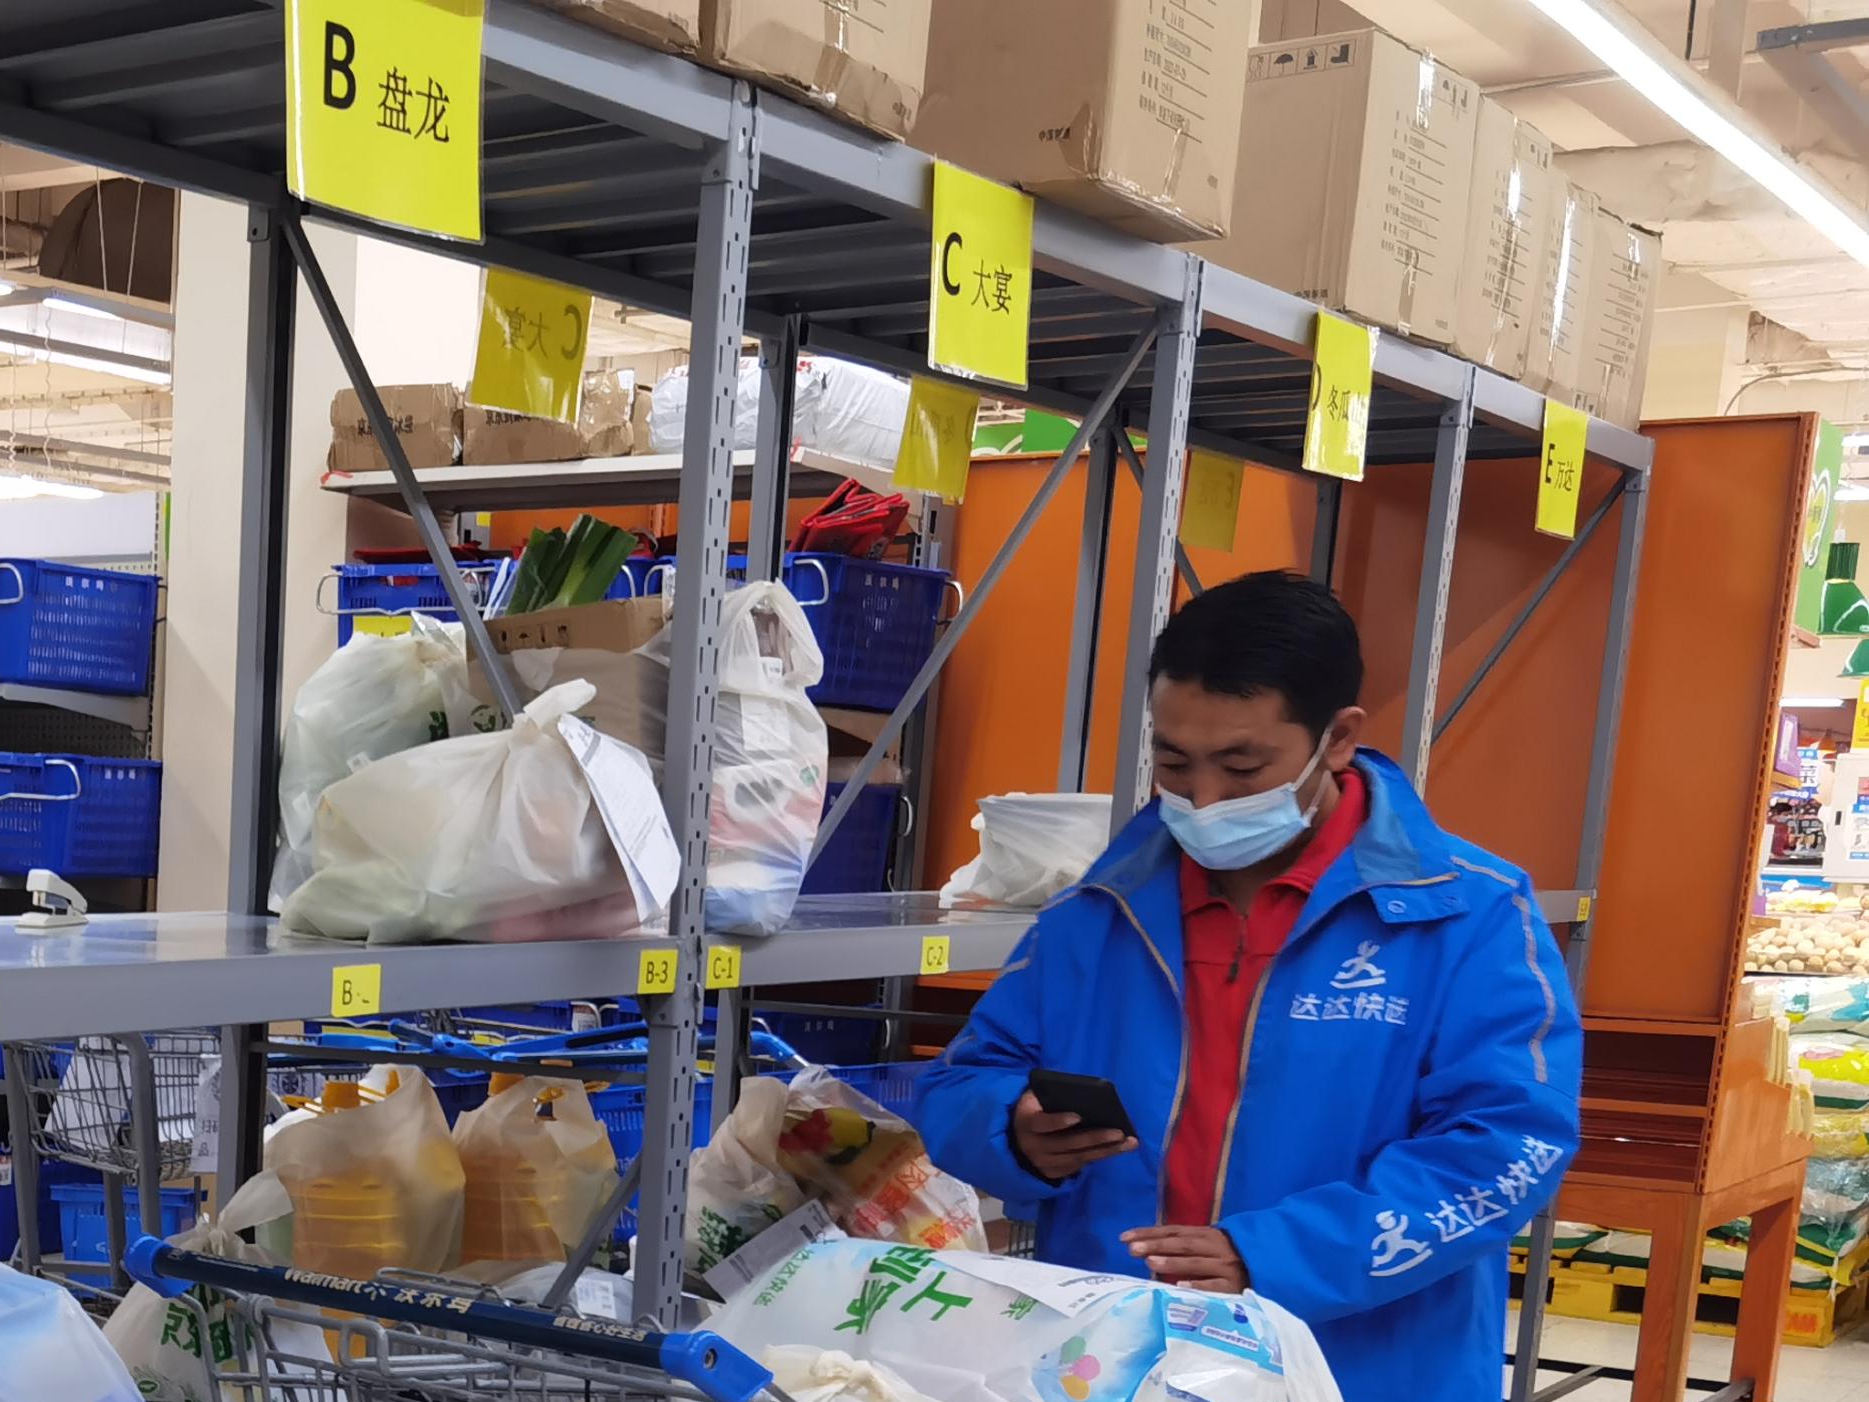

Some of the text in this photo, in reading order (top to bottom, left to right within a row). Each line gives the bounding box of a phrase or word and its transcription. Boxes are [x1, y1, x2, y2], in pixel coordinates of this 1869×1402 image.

[323, 20, 450, 142] B 盘龙
[942, 231, 1013, 315] C 大宴
[1544, 443, 1576, 492] E 万达
[645, 959, 669, 985] B-3
[712, 956, 734, 980] C-1
[925, 945, 945, 967] C-2
[1289, 991, 1410, 1025] 达达快送
[1424, 1134, 1565, 1243] 达达快送
